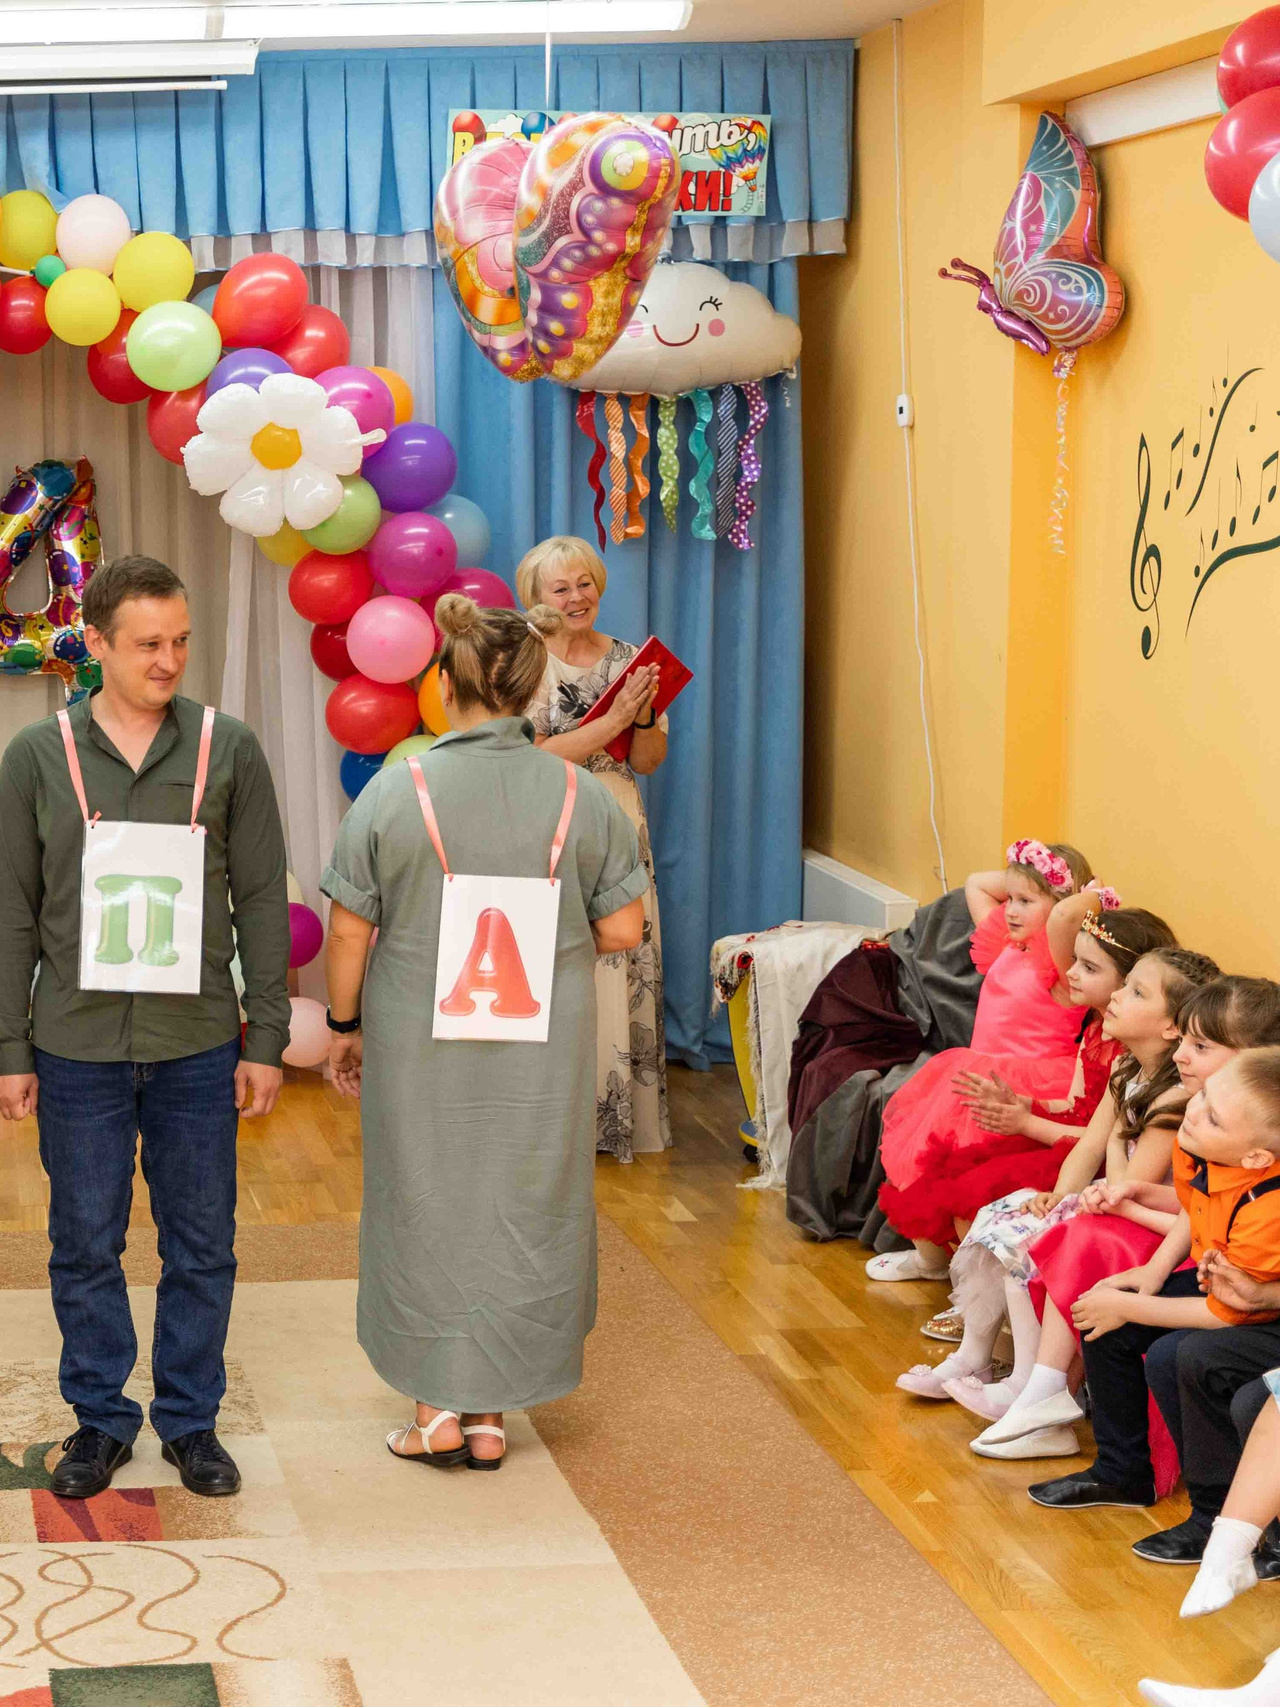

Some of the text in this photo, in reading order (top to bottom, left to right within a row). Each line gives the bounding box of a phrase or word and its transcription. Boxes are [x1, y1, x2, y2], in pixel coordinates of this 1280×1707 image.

[674, 170, 733, 212] КИ!
[94, 874, 183, 966] П
[439, 907, 541, 1019] А
